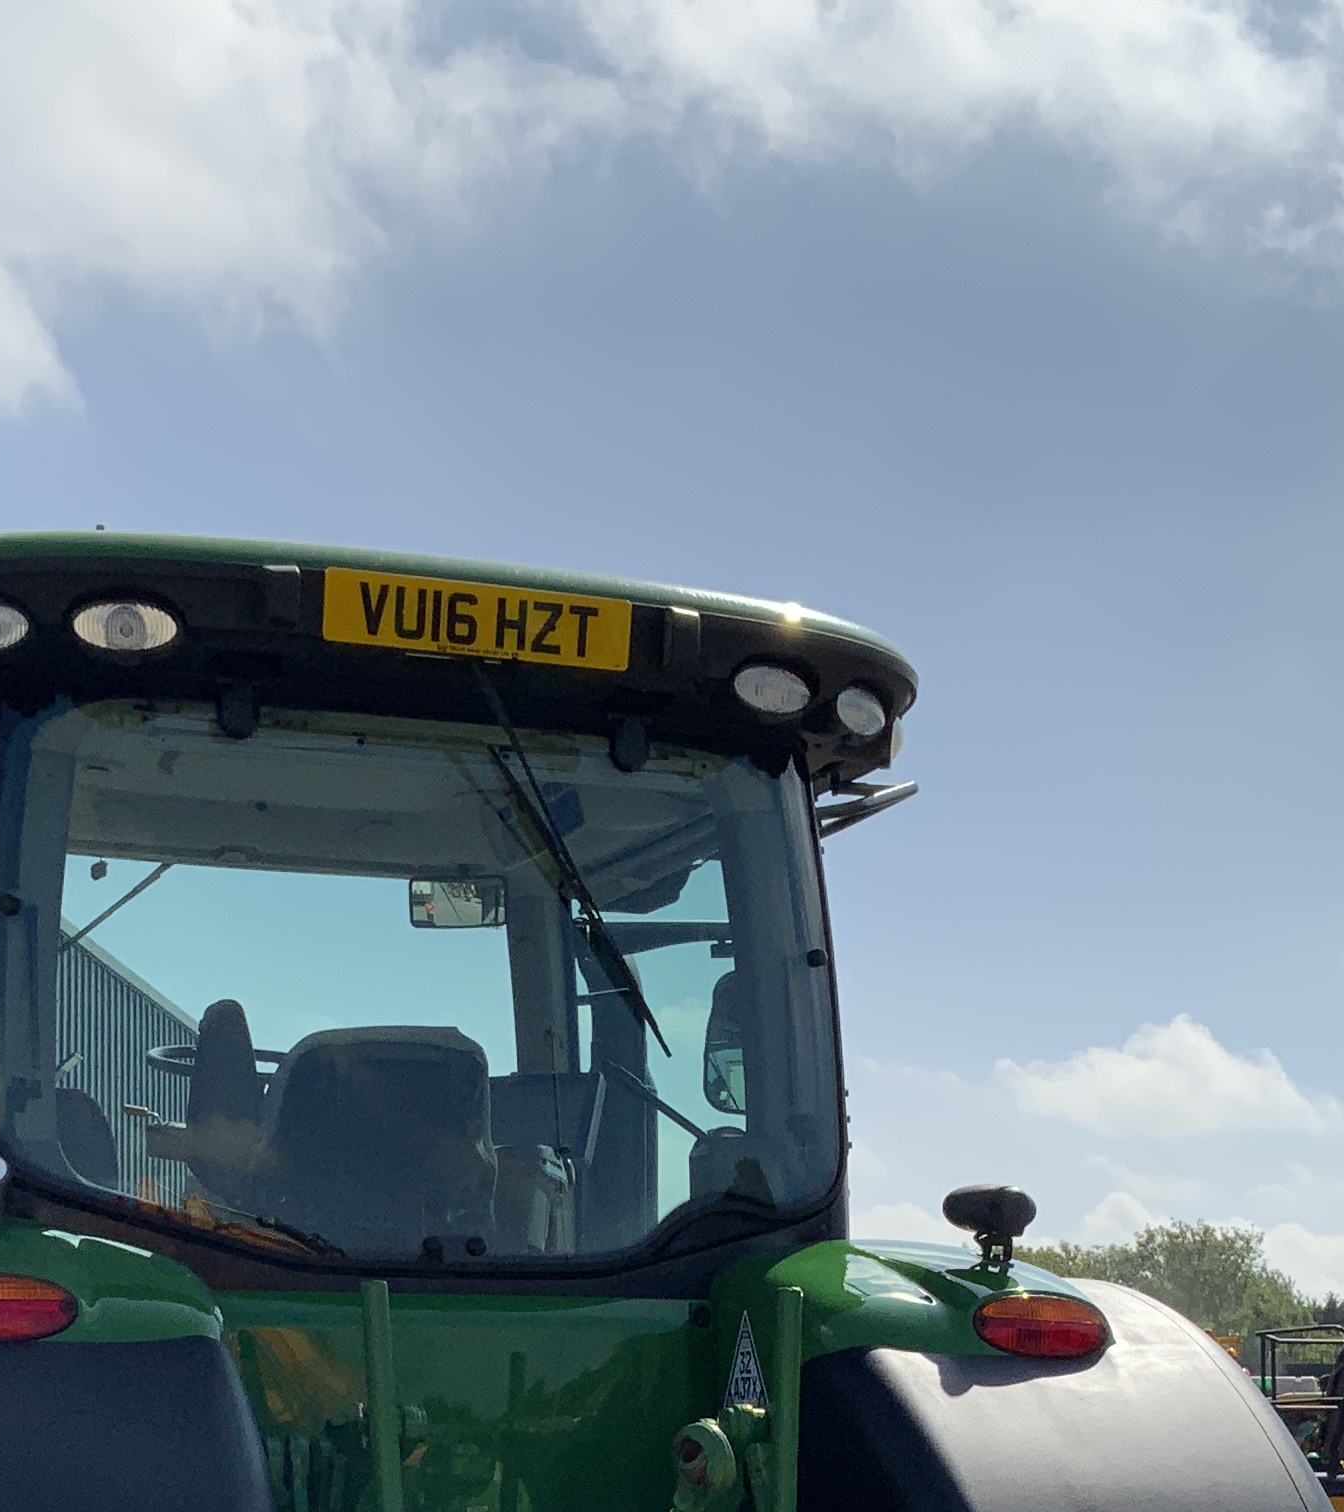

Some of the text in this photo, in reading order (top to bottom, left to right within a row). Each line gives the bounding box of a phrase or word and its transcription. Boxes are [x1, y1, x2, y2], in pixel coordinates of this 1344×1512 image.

[359, 581, 600, 659] VU16 HZT
[739, 1350, 752, 1375] 32
